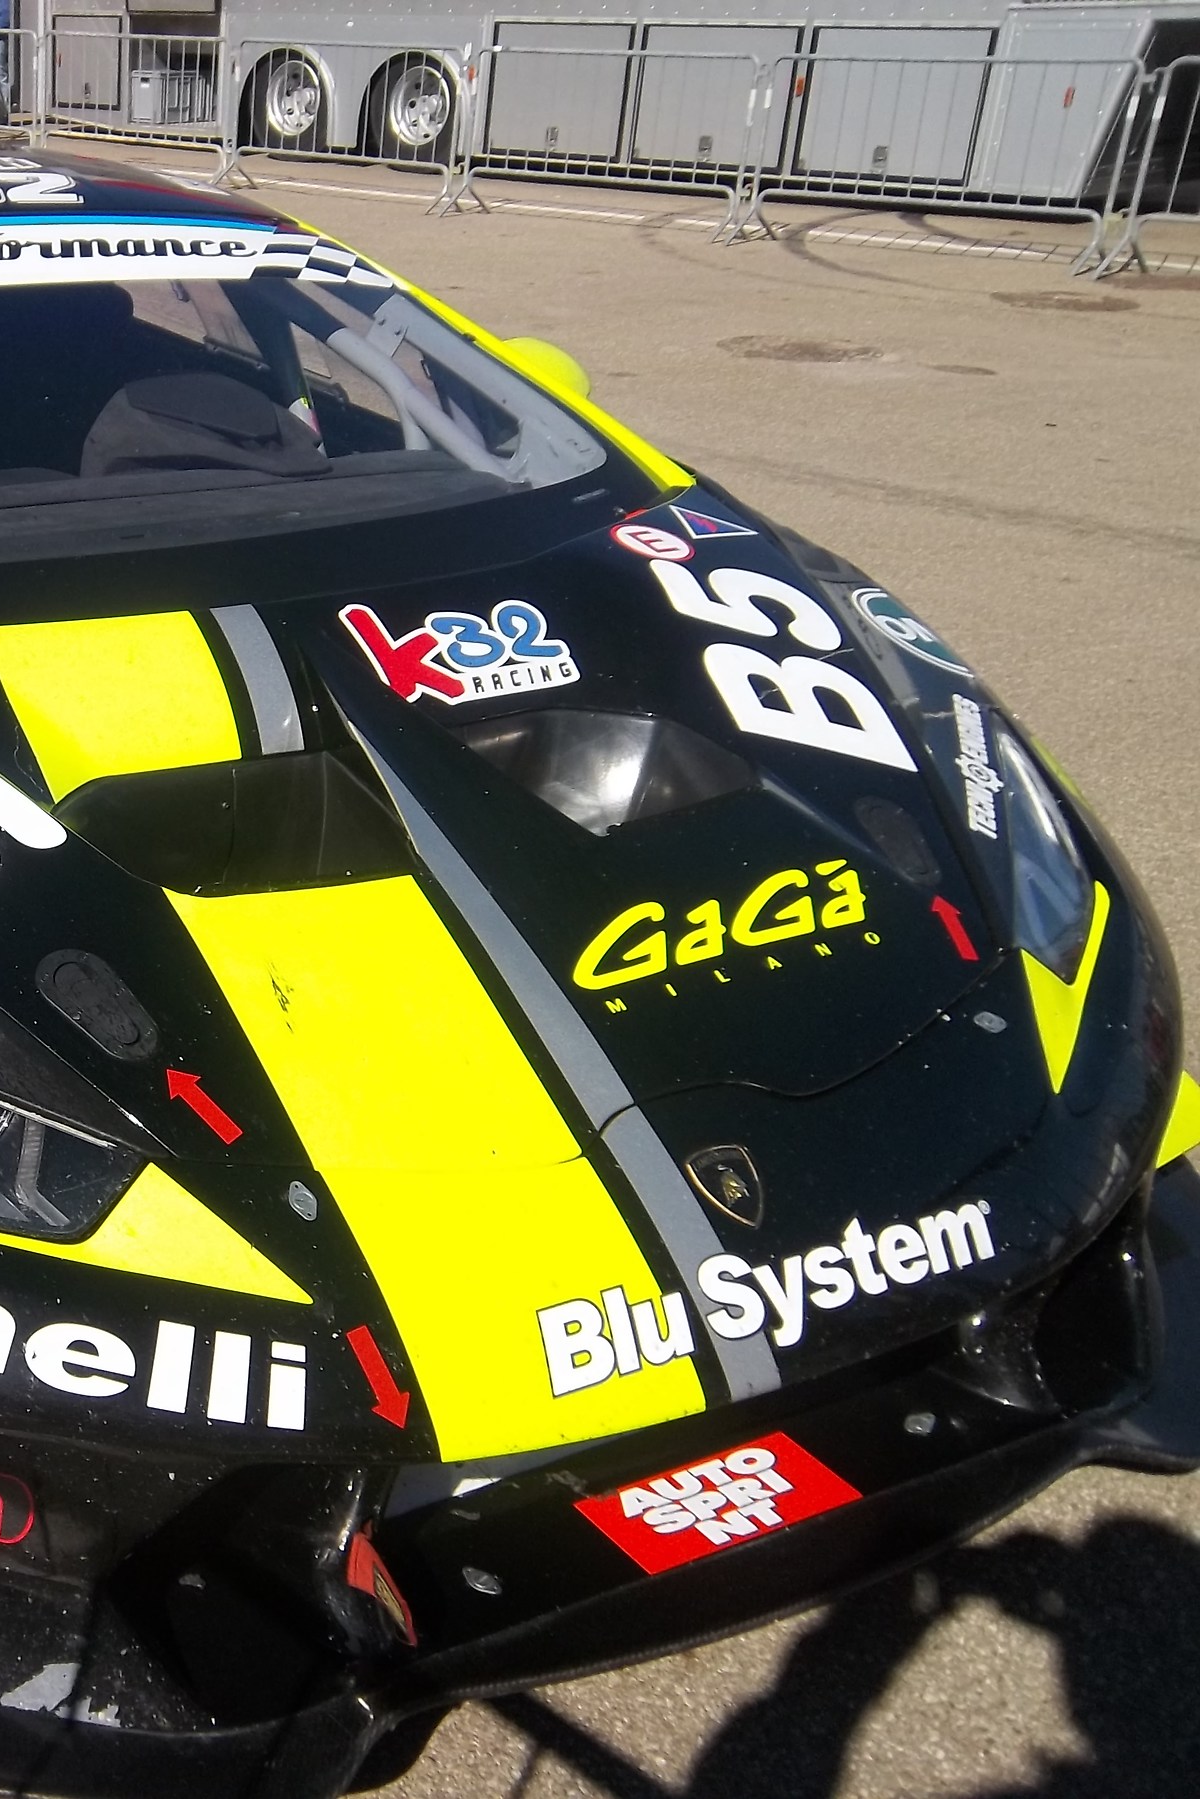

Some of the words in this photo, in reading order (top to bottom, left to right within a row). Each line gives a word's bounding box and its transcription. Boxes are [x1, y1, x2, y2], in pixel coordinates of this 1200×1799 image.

[472, 661, 572, 694] RACING
[650, 558, 919, 772] B5
[604, 931, 882, 1014] MILANO
[619, 1447, 777, 1519] AUTO
[642, 1468, 795, 1534] SPRI
[695, 1497, 784, 1546] NT
